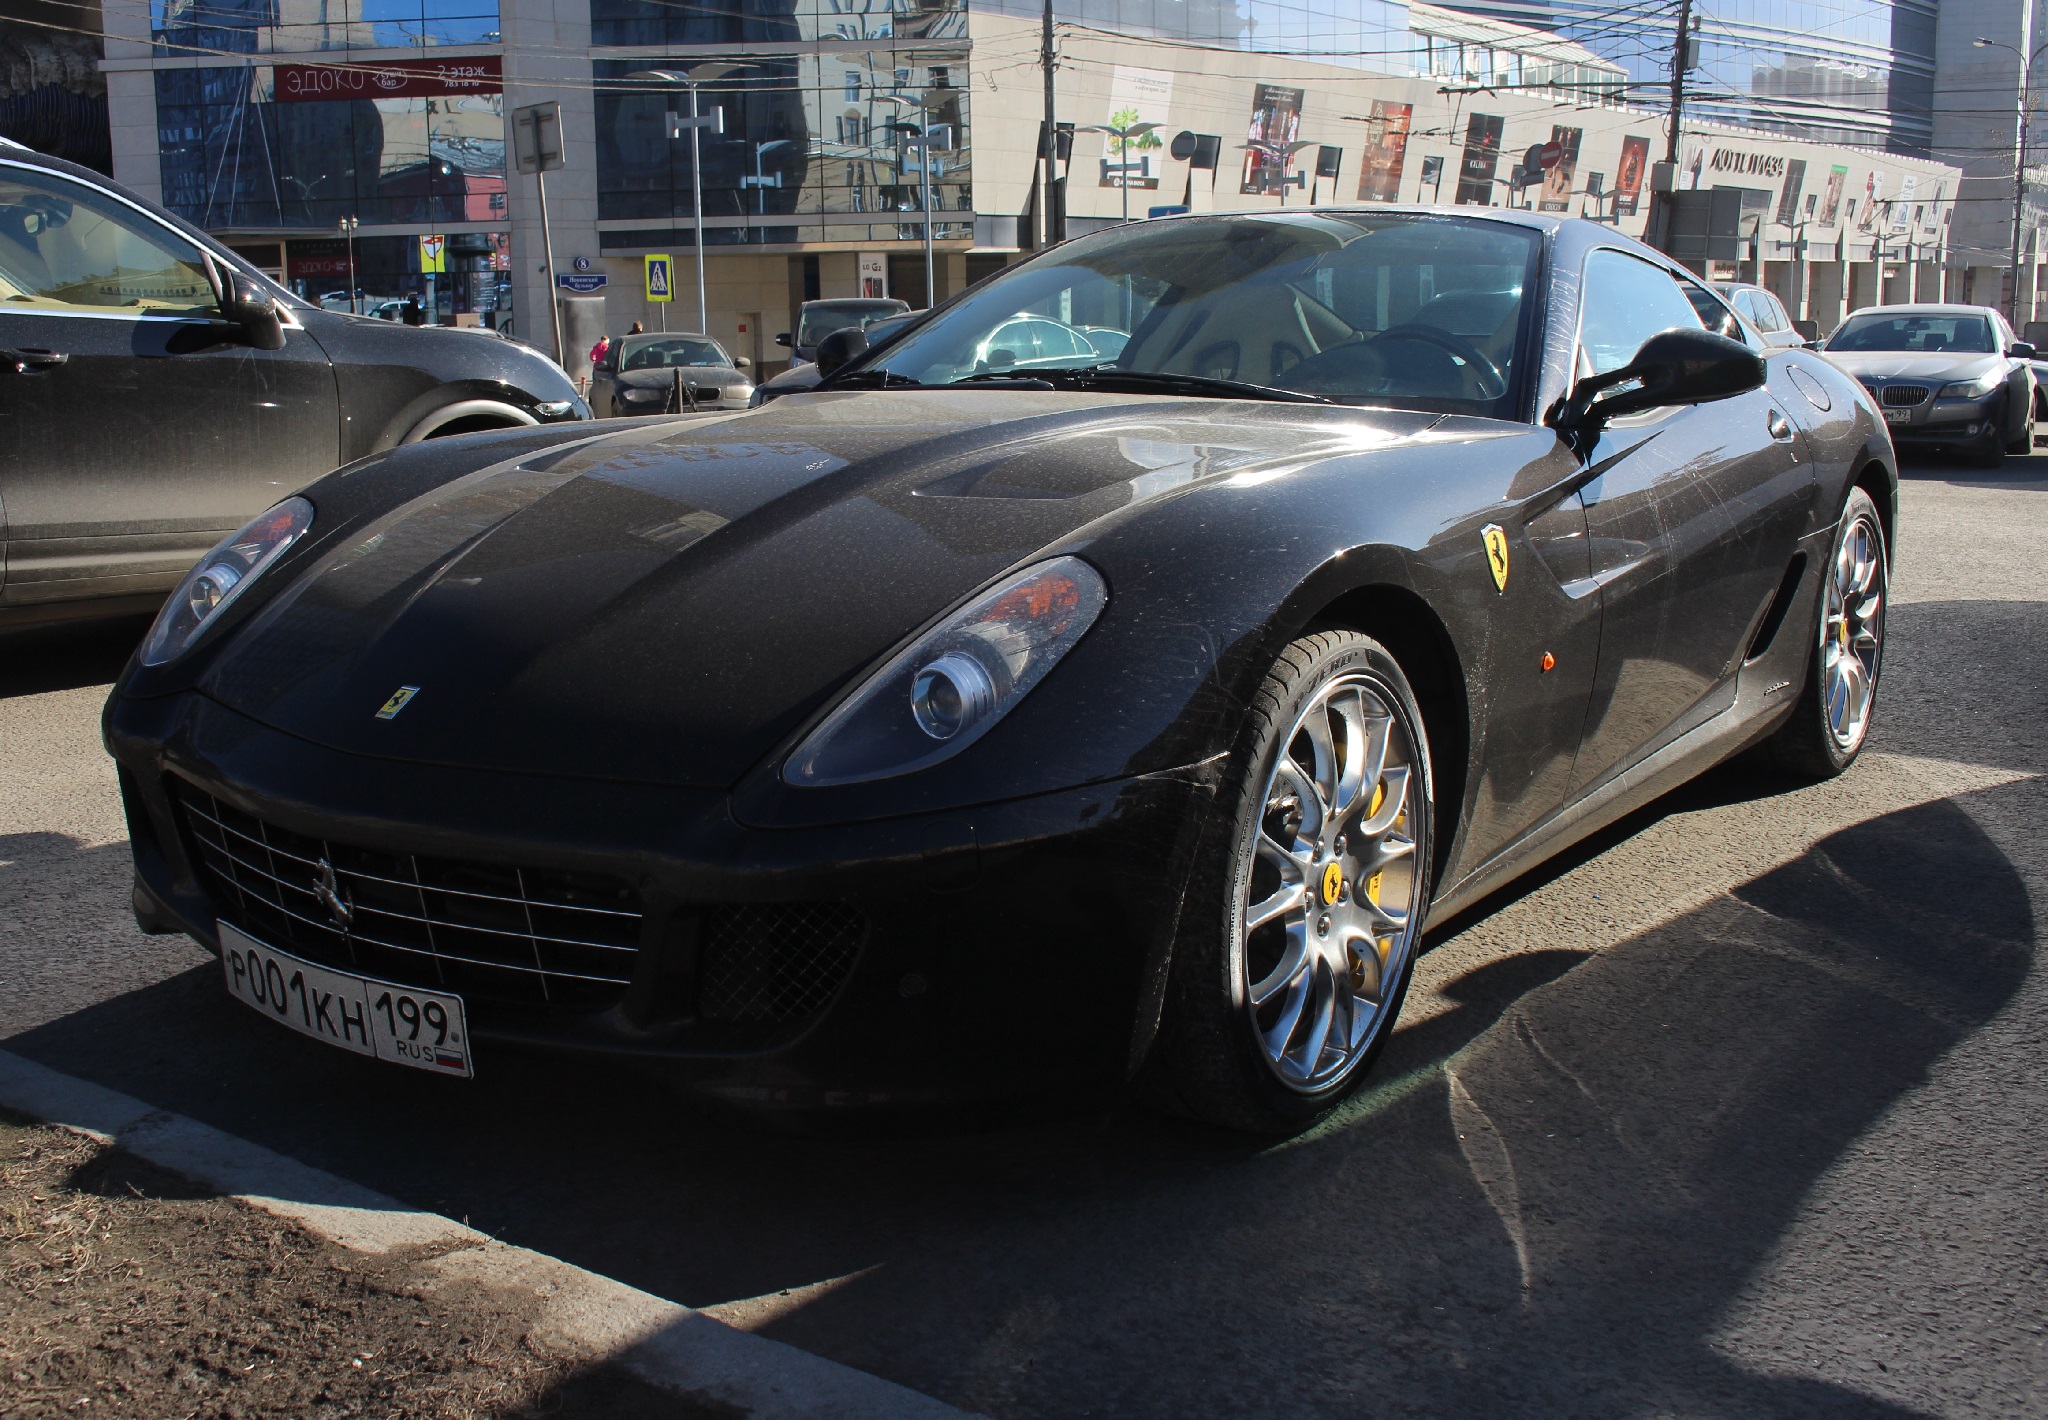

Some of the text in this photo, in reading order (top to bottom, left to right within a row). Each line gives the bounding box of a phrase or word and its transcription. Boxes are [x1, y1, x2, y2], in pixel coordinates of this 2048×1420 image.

[437, 65, 486, 79] 2 этаж
[286, 69, 364, 95] ЭДОКО
[381, 79, 397, 87] бар
[580, 259, 587, 269] 8
[375, 990, 449, 1046] 199
[396, 1039, 434, 1062] RUS
